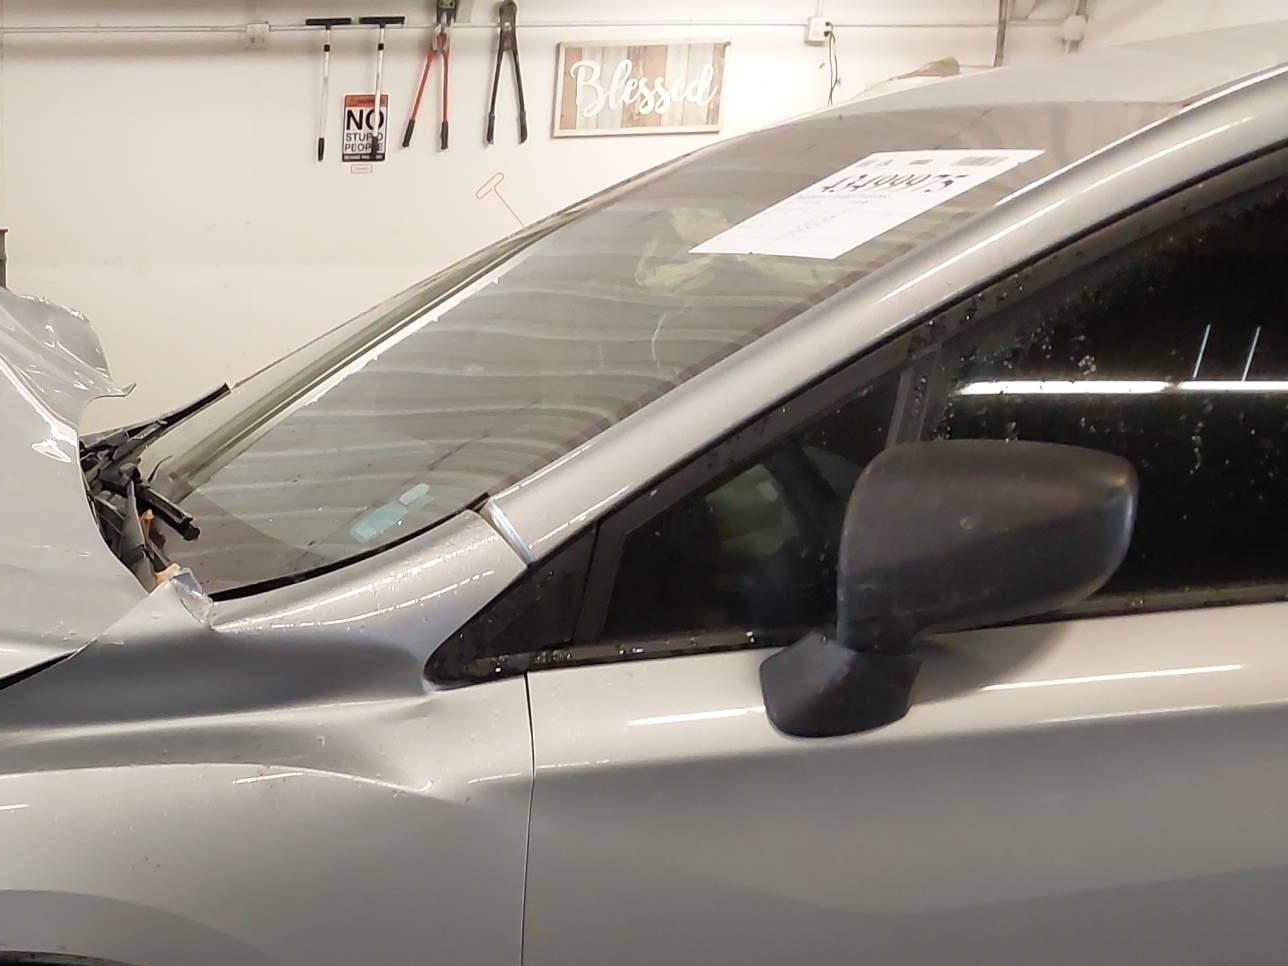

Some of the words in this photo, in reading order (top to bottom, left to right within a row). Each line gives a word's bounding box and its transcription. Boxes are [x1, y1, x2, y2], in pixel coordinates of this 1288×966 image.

[569, 58, 719, 117] Blessed
[346, 109, 385, 131] NO
[345, 132, 384, 142] STUPD
[344, 142, 384, 152] PEOPE
